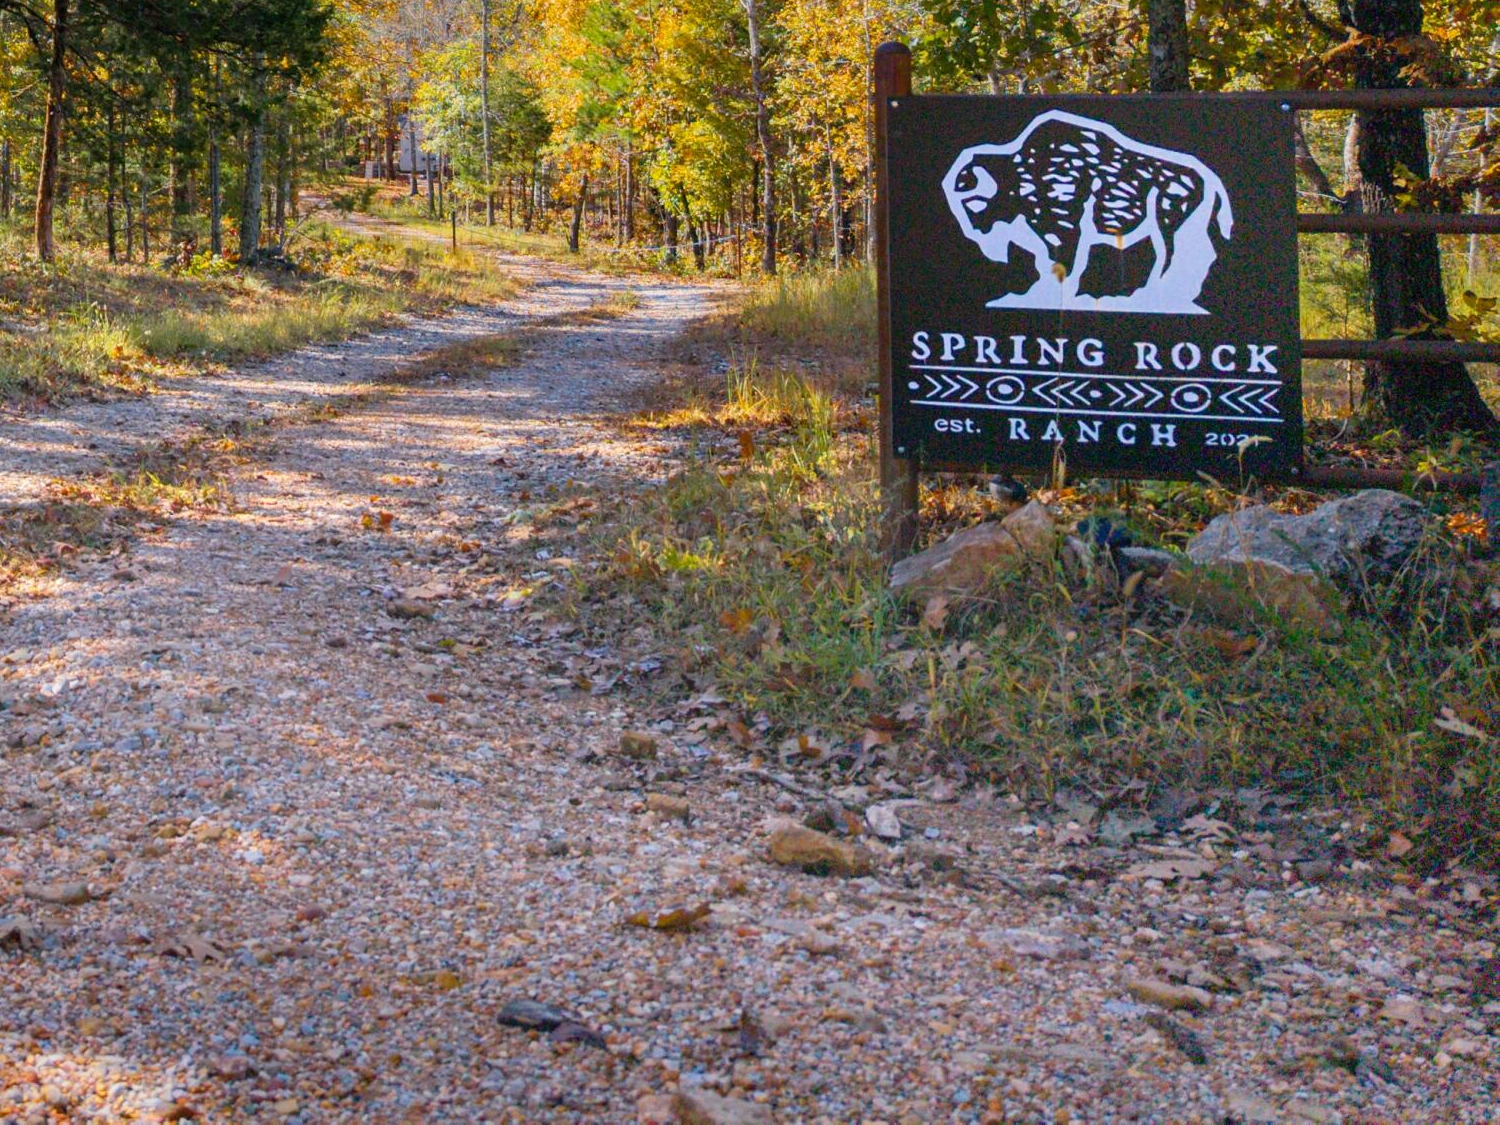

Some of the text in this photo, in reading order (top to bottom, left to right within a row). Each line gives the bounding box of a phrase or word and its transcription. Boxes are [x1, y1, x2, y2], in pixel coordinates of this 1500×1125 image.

[911, 331, 1279, 374] SPRING ROCK
[934, 416, 982, 434] est.
[1008, 417, 1178, 448] RANCH
